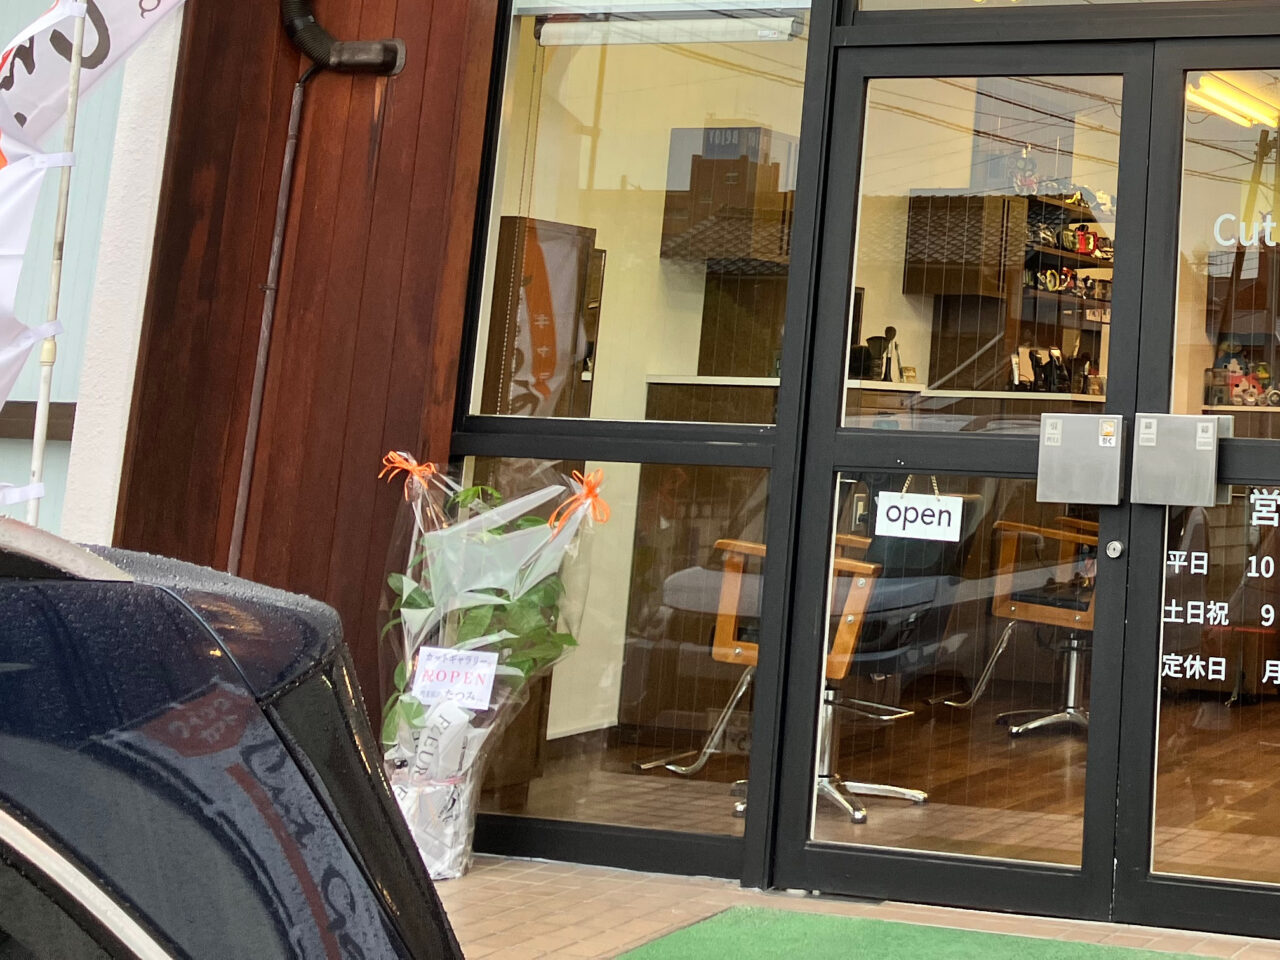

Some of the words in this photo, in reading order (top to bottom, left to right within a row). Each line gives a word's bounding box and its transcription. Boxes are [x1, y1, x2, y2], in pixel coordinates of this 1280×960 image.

[1213, 212, 1277, 248] Cut
[886, 505, 952, 531] open
[1166, 550, 1209, 576] 平日
[1163, 599, 1229, 627] 土日祝
[1161, 654, 1227, 682] 定休日
